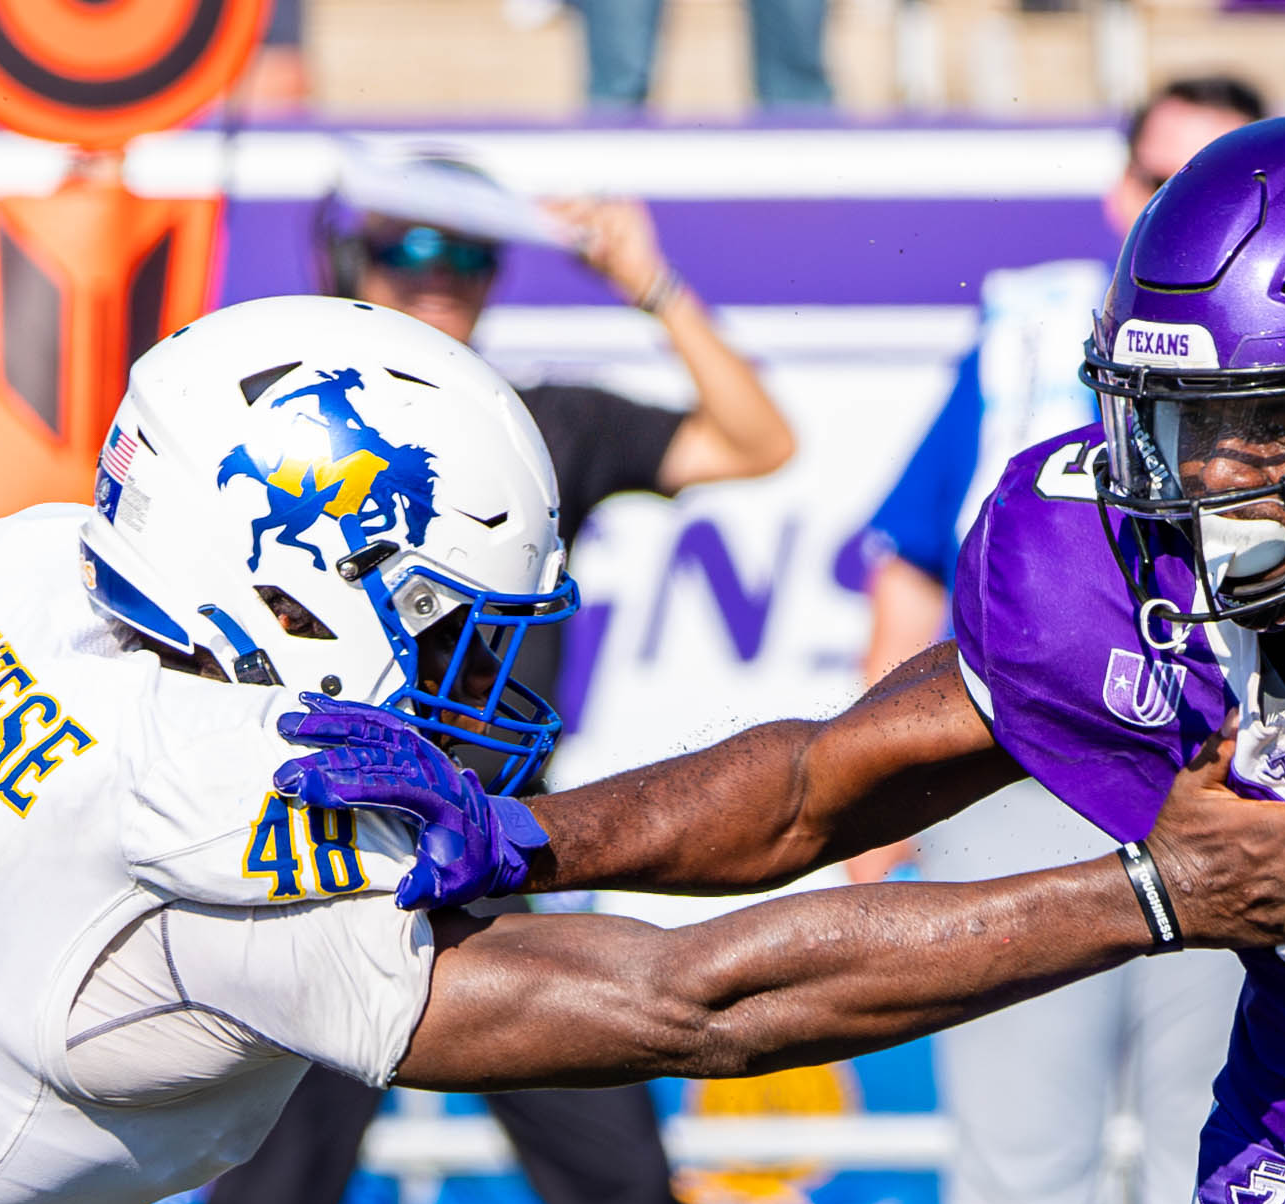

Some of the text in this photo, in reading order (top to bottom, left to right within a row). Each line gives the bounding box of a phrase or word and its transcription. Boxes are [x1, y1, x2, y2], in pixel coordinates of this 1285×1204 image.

[1126, 329, 1190, 357] TEXANS
[242, 791, 370, 902] 48
[1138, 862, 1174, 942] TOUGHNESS
